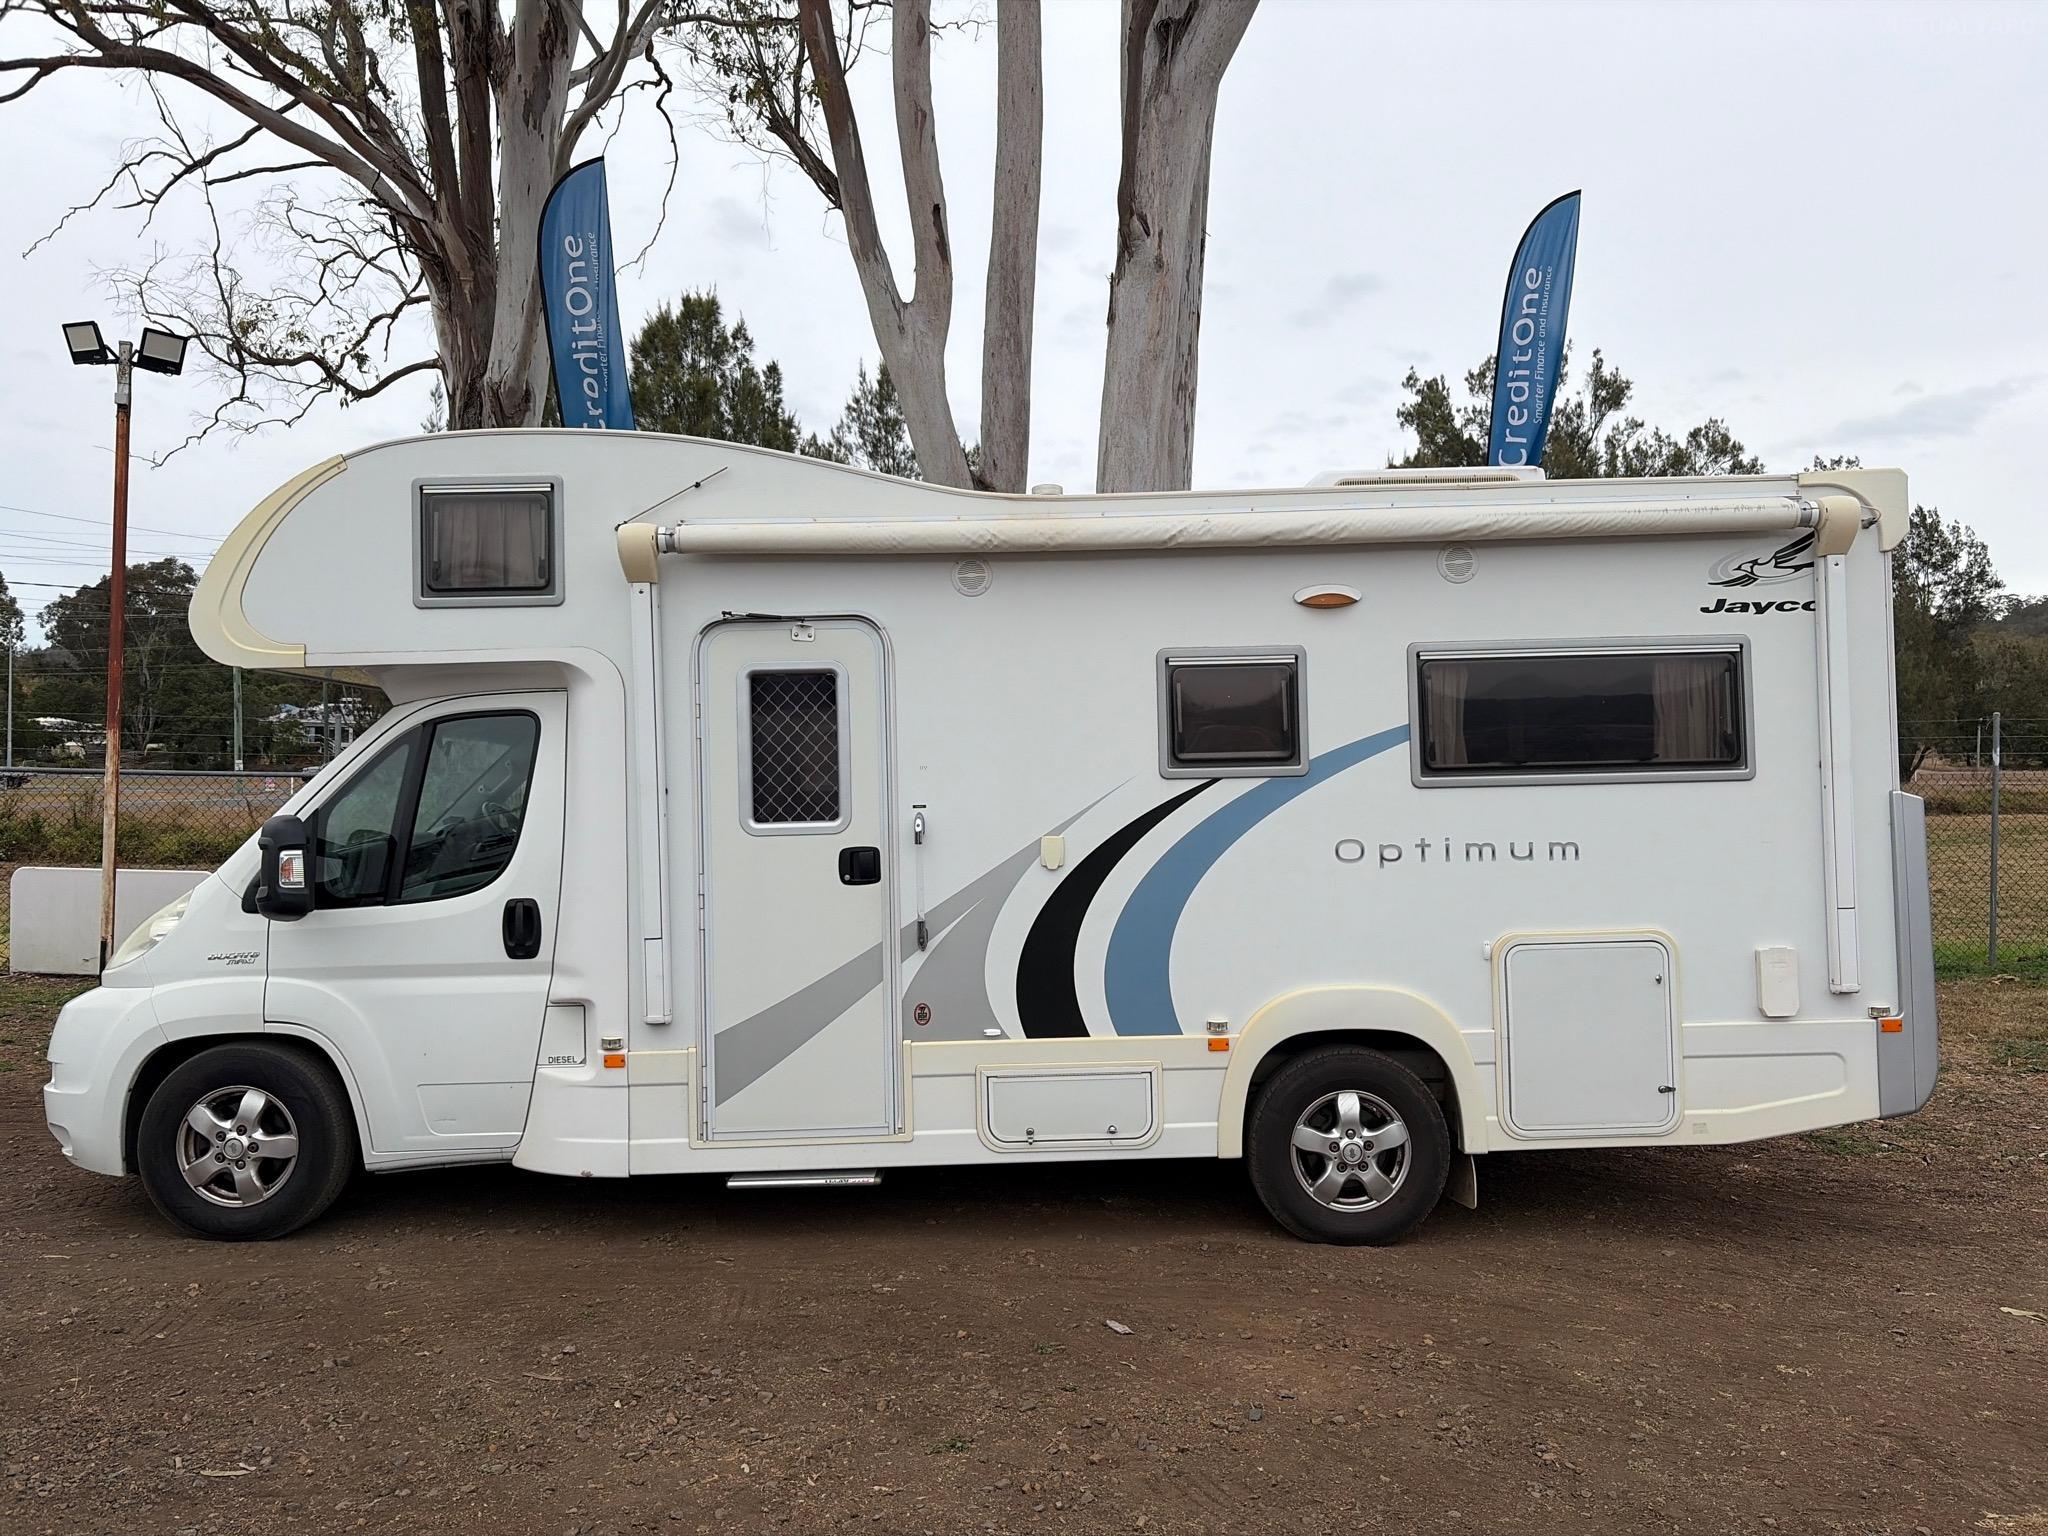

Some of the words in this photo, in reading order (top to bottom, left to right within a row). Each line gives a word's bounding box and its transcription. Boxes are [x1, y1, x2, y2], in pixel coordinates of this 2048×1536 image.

[1539, 265, 1553, 316] Insurance
[1538, 318, 1547, 338] and
[1498, 267, 1542, 466] CreditOne
[1534, 340, 1546, 380] Finance
[1533, 382, 1545, 424] Smarter
[1334, 837, 1580, 869] Optimum
[548, 1056, 577, 1064] DIESEL
